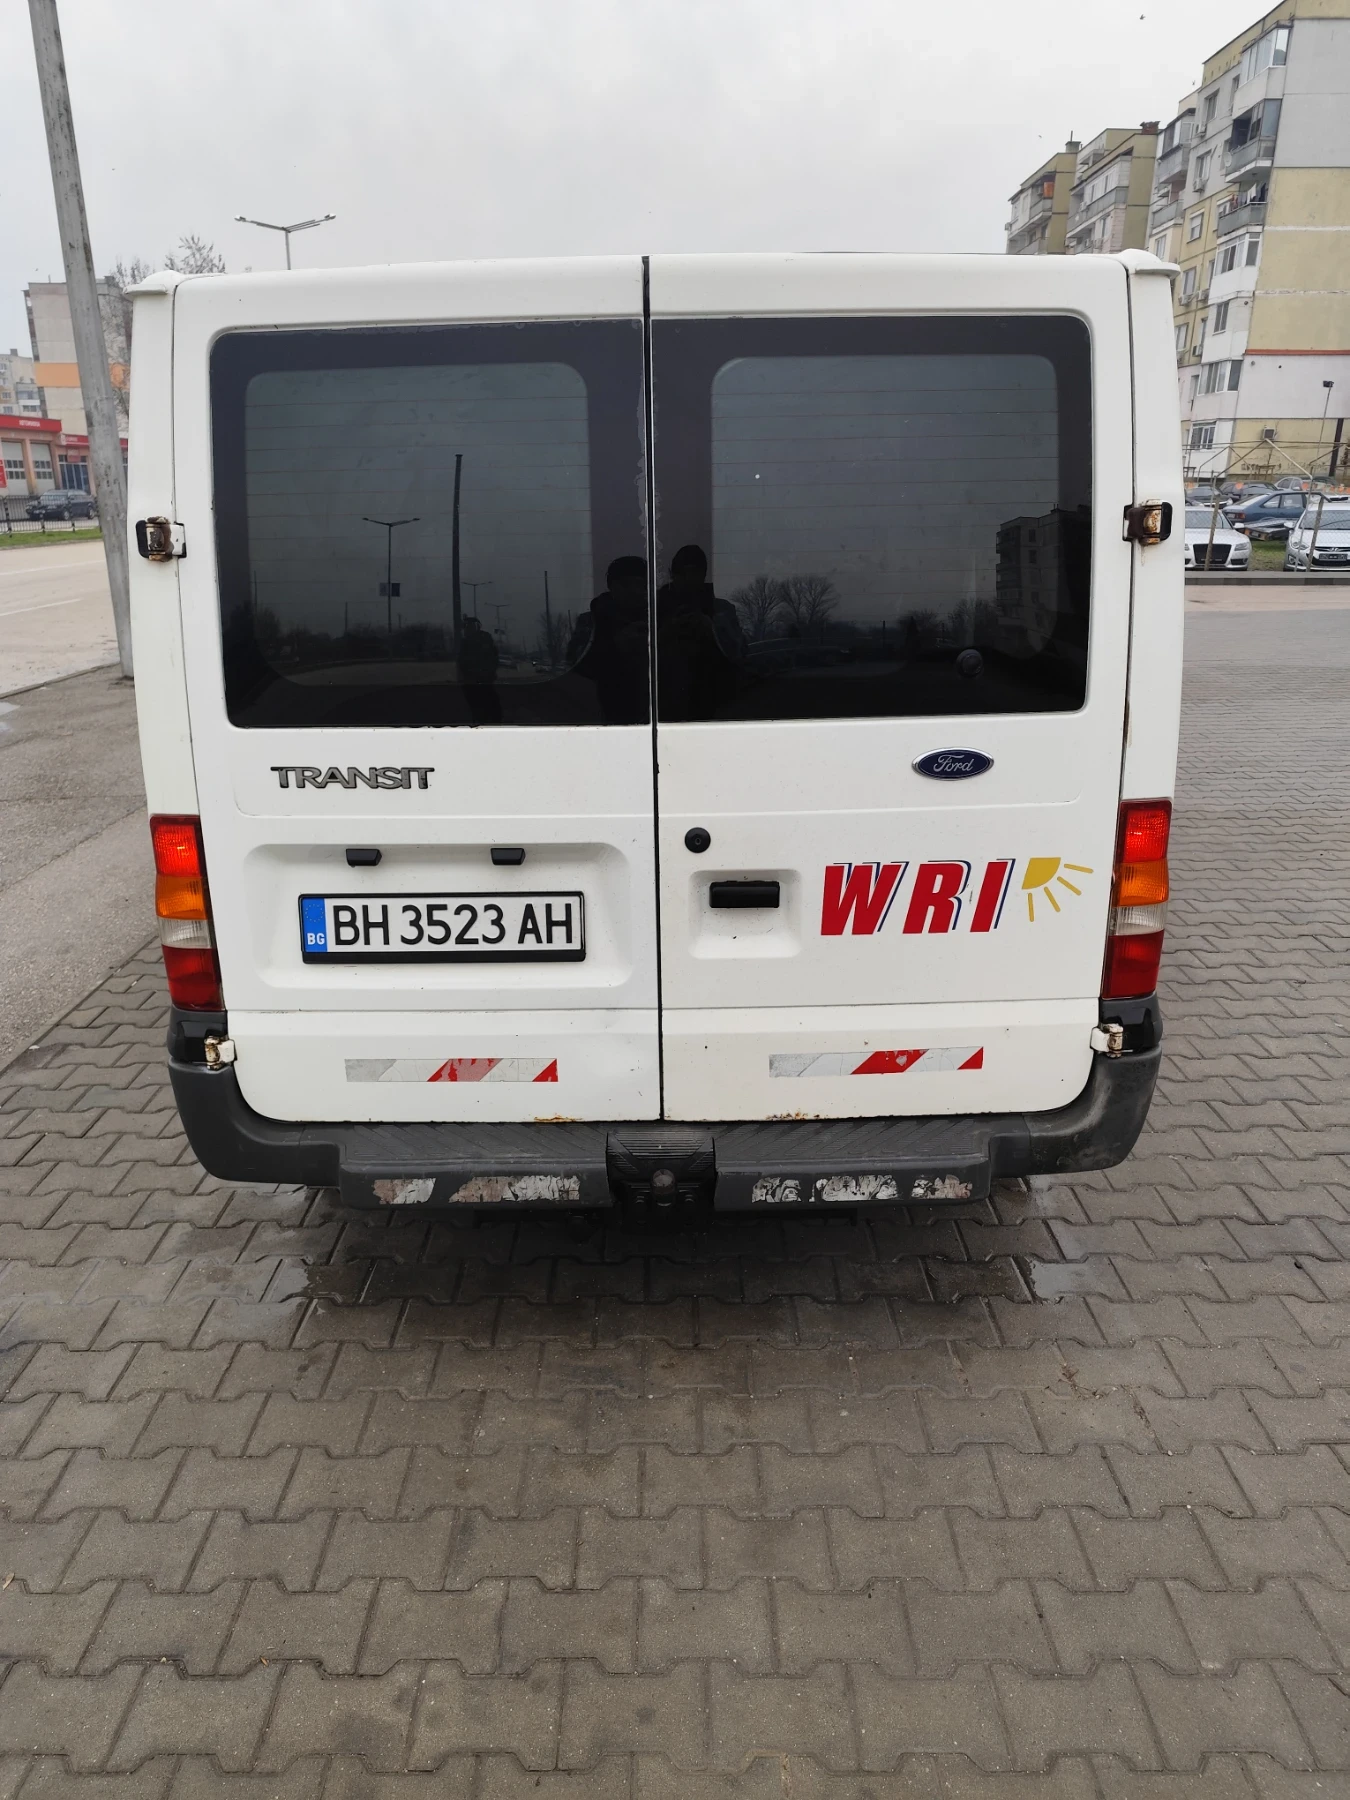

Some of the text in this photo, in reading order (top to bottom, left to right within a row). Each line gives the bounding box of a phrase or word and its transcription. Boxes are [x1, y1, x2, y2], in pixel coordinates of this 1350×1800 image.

[933, 754, 975, 772] Ford
[270, 767, 435, 789] TRANSIT
[820, 858, 1016, 936] WRI
[333, 903, 573, 946] BH 3523 AH
[307, 933, 326, 946] BG
